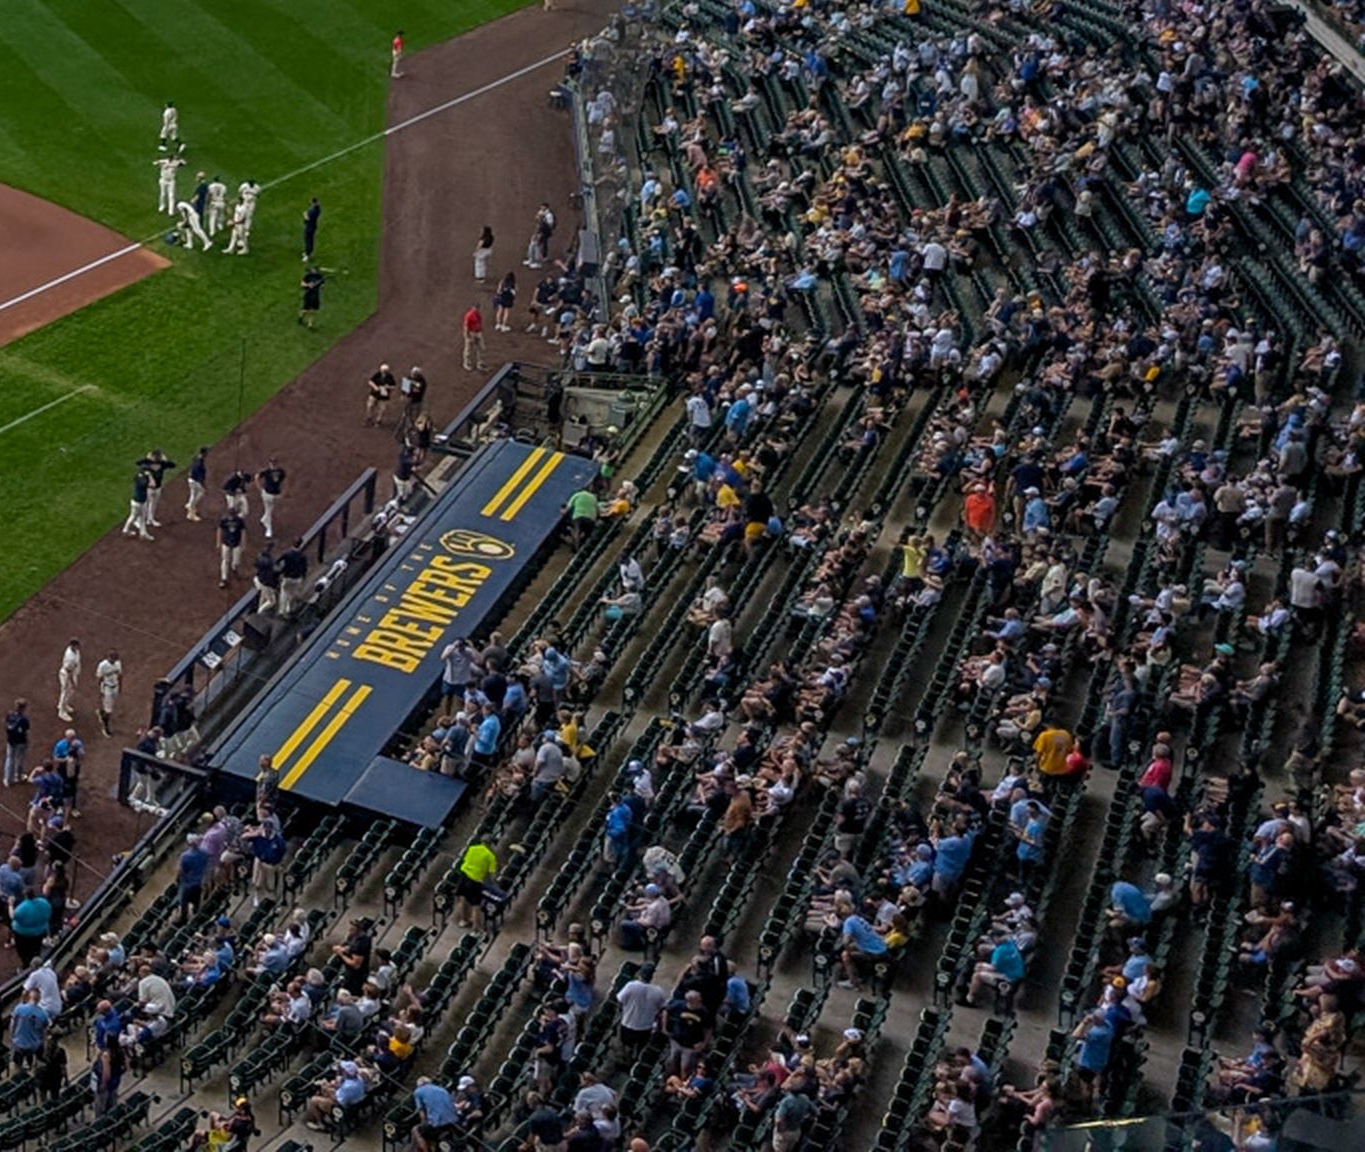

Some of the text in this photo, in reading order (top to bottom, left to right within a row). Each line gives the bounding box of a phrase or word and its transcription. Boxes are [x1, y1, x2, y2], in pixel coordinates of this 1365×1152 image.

[326, 614, 372, 660] HOME
[401, 541, 434, 572] THE
[351, 553, 493, 675] BREWERS
